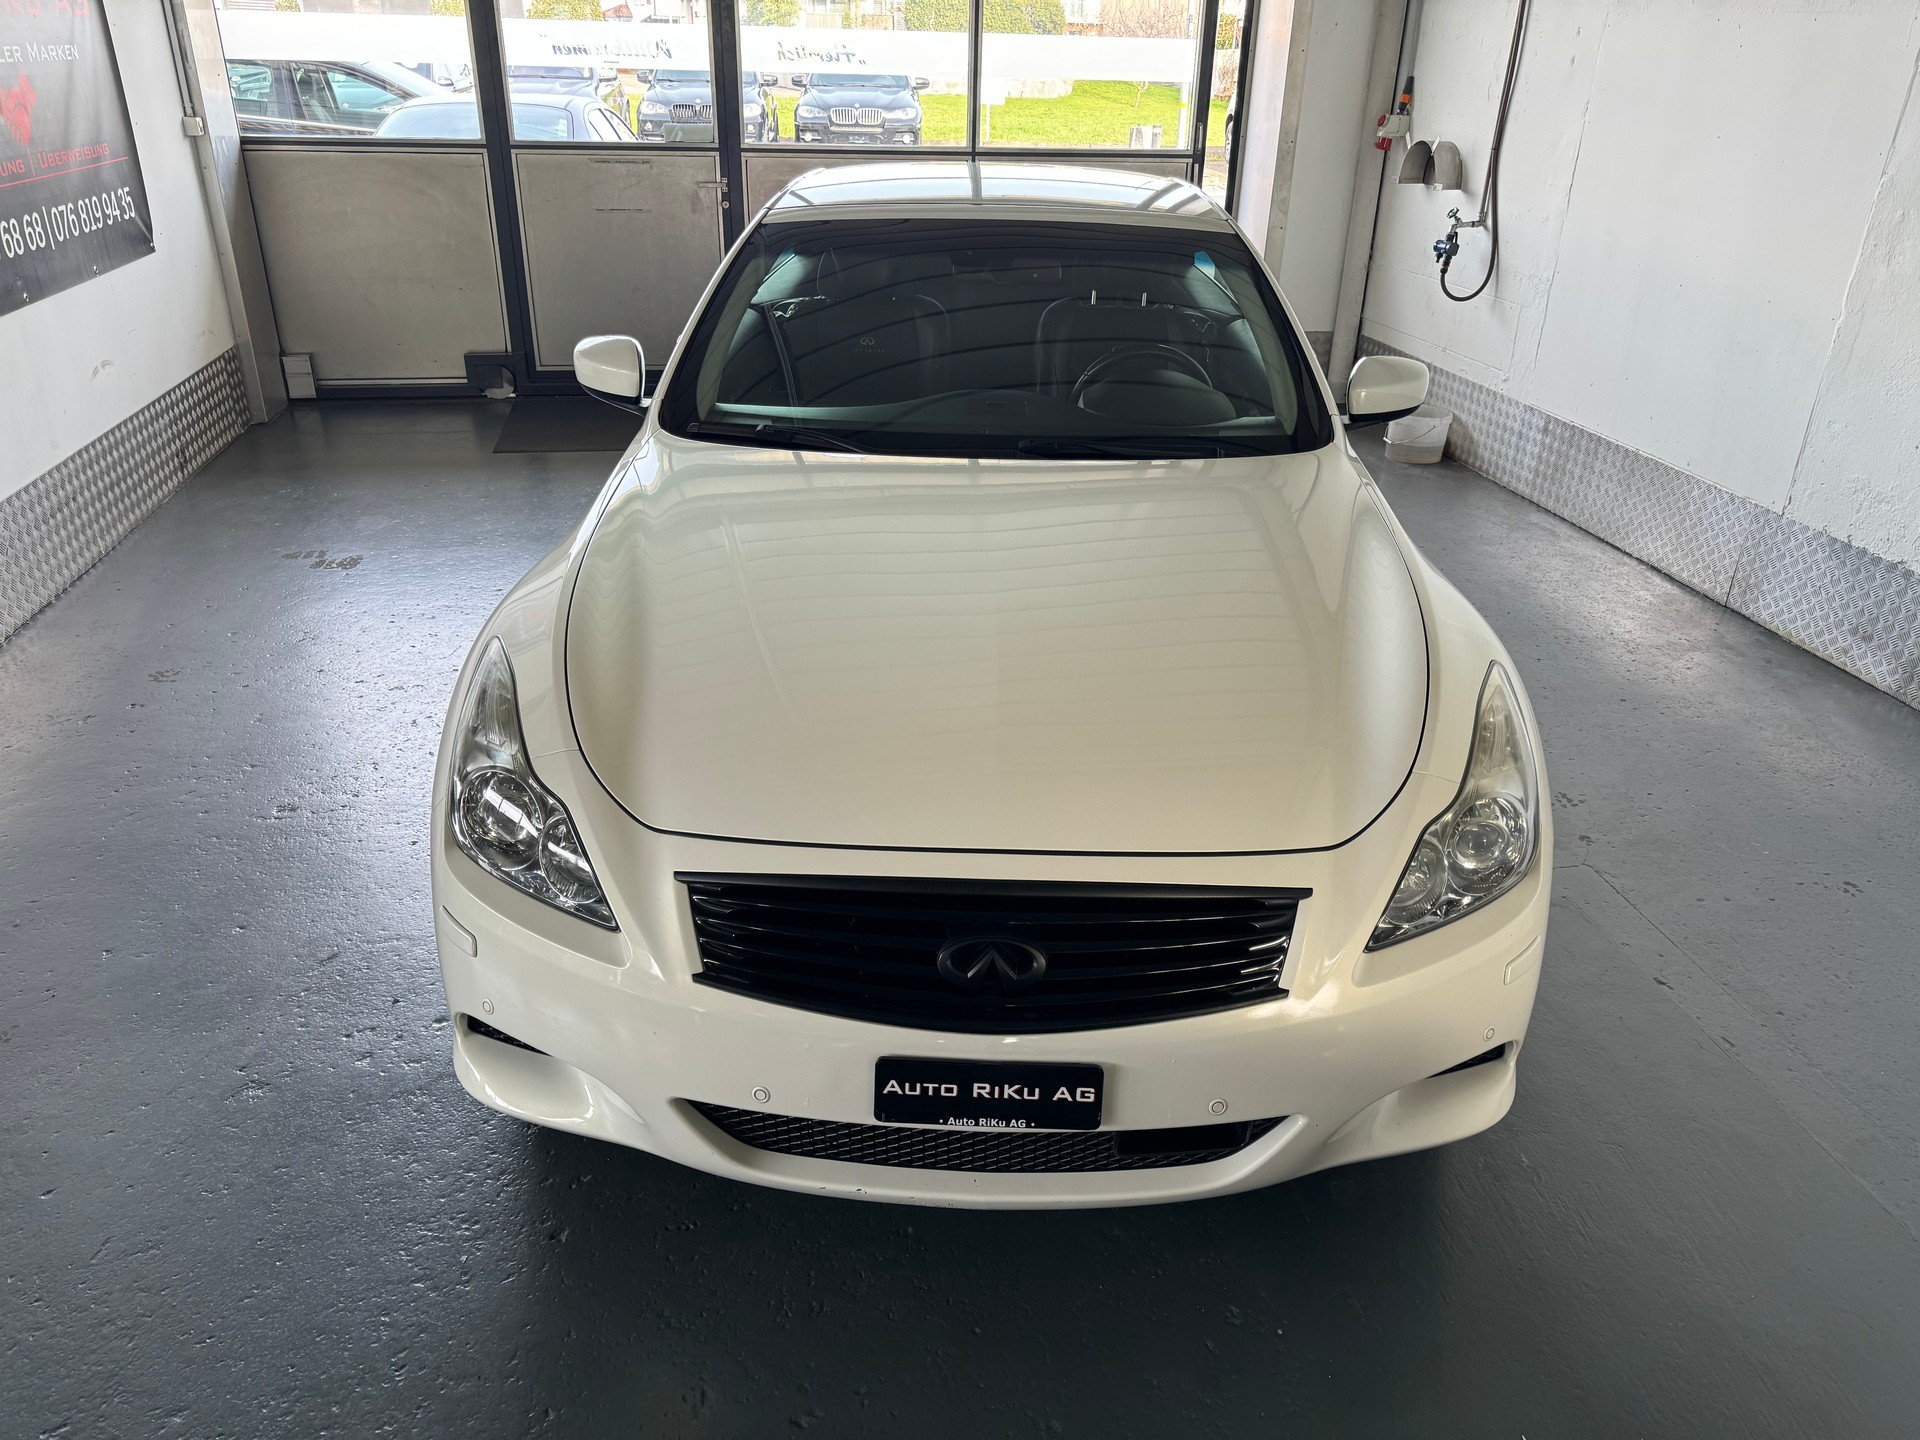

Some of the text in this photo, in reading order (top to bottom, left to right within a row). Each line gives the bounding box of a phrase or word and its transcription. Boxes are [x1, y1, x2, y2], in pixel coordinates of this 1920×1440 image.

[26, 41, 79, 62] MARKEN
[37, 143, 110, 169] ÜBERWEISUNG
[0, 218, 24, 258] 68
[23, 212, 46, 251] 68
[51, 202, 79, 242] 076
[78, 195, 103, 234] 819
[101, 191, 121, 225] 94
[118, 186, 135, 220] 35
[882, 1079, 958, 1097] AUTO
[1052, 1086, 1096, 1102] AG
[947, 1117, 1027, 1128] Auto RiKu AG
